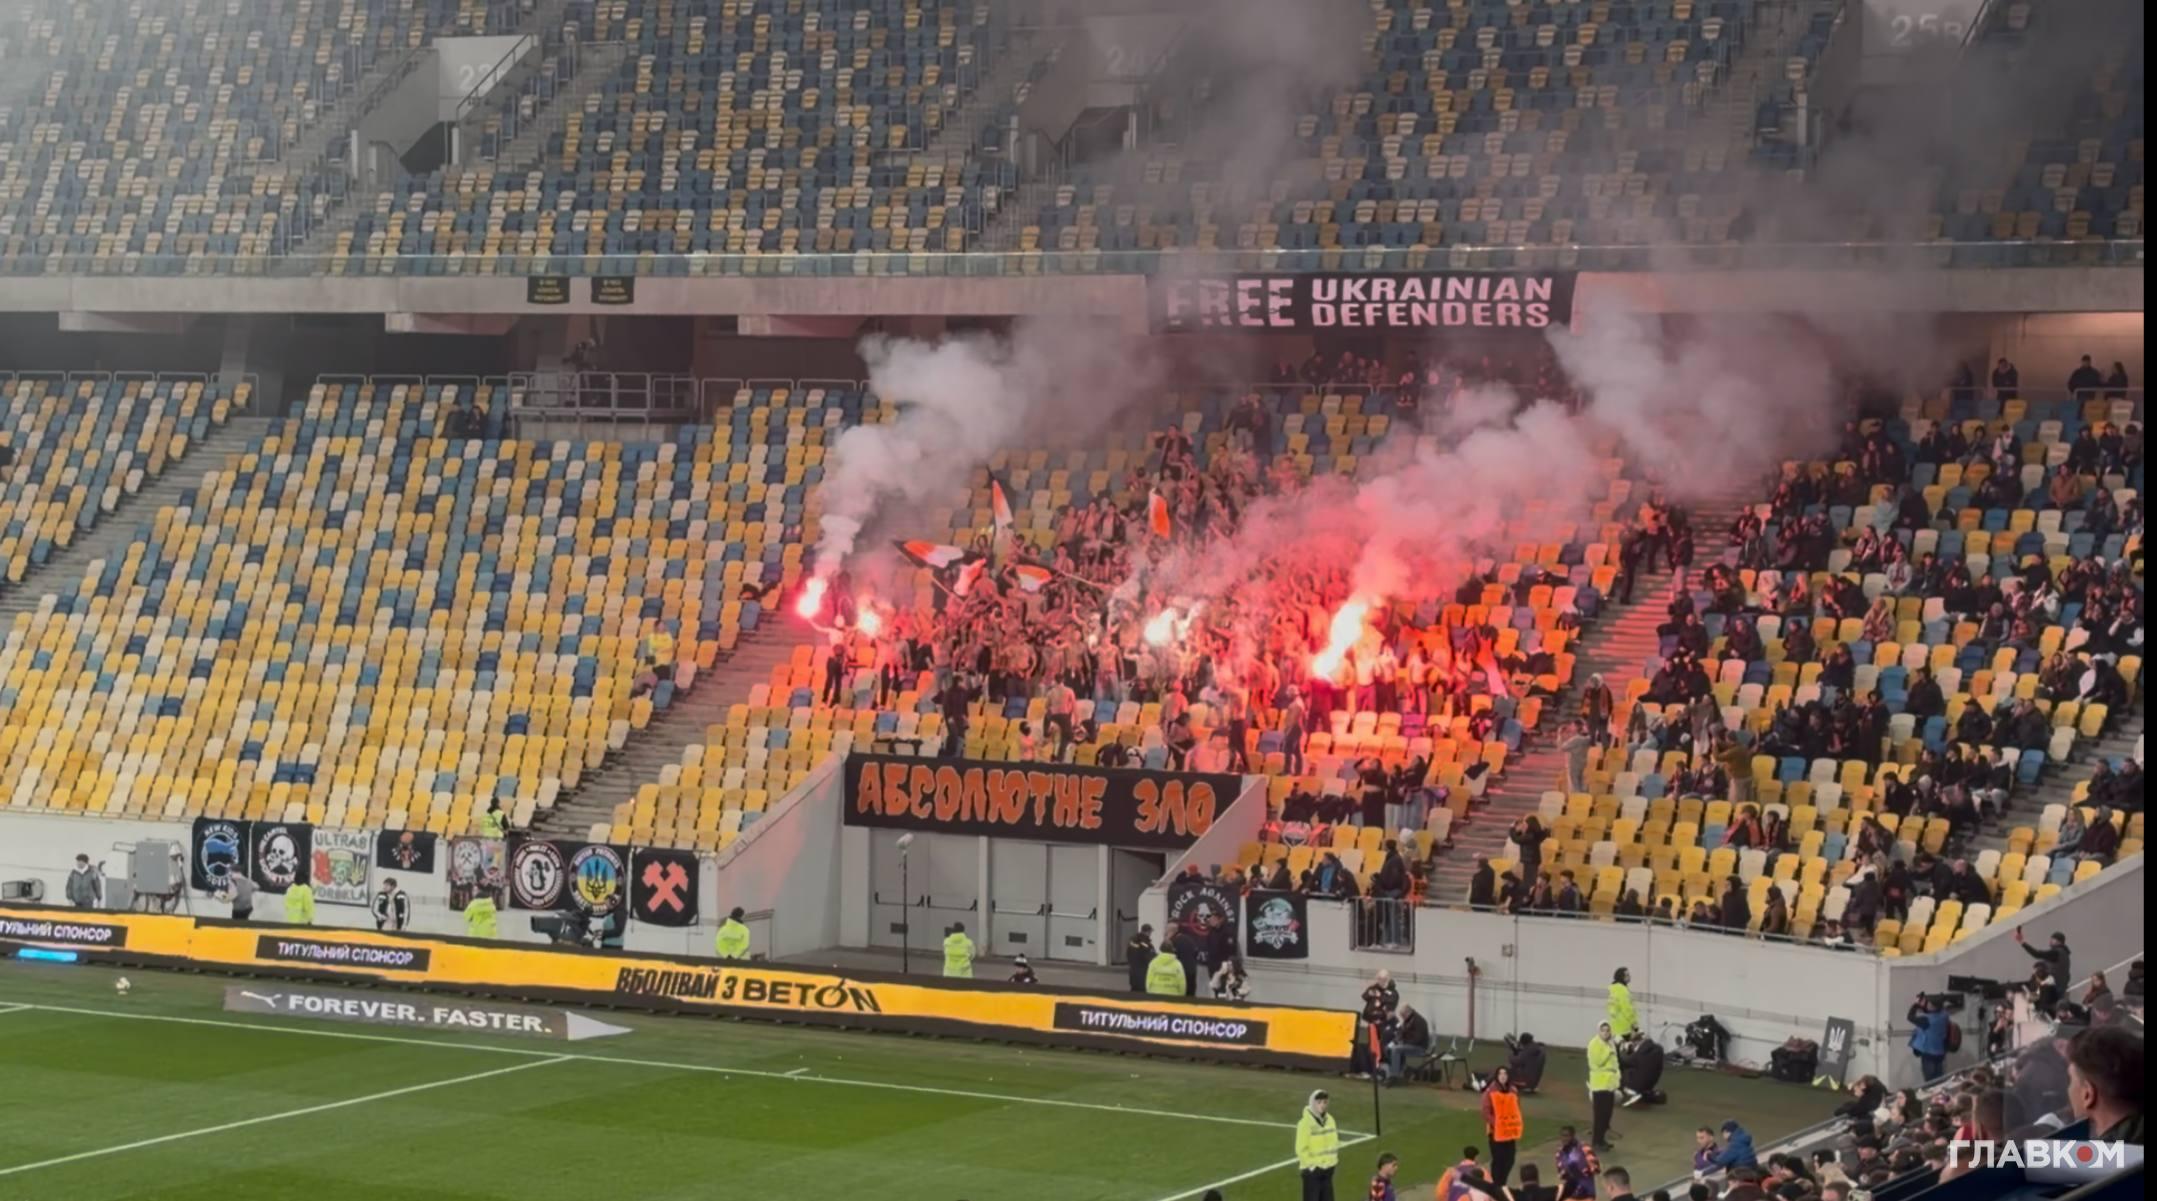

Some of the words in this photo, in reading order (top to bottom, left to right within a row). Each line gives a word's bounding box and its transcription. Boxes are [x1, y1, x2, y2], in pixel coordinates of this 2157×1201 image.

[1167, 278, 1296, 327] FREE
[1311, 277, 1553, 302] UKRAINIAN
[1311, 301, 1551, 328] DEFENDERS
[856, 761, 1108, 830] АБСОЛЮТНЕ
[1132, 778, 1217, 837] ЗЛО
[54, 925, 112, 941] СПОНСОР
[278, 942, 349, 960] ТИТУЛЬНИЙ
[352, 948, 413, 965] СПОНСОР
[615, 966, 721, 999] ВБОЛІВАЙ
[289, 994, 425, 1022] FOREVER.
[433, 1007, 552, 1033] FASTER.
[1080, 1010, 1169, 1032] ТИТУЛЬНИЙ
[1171, 1019, 1247, 1038] СПОНСОР
